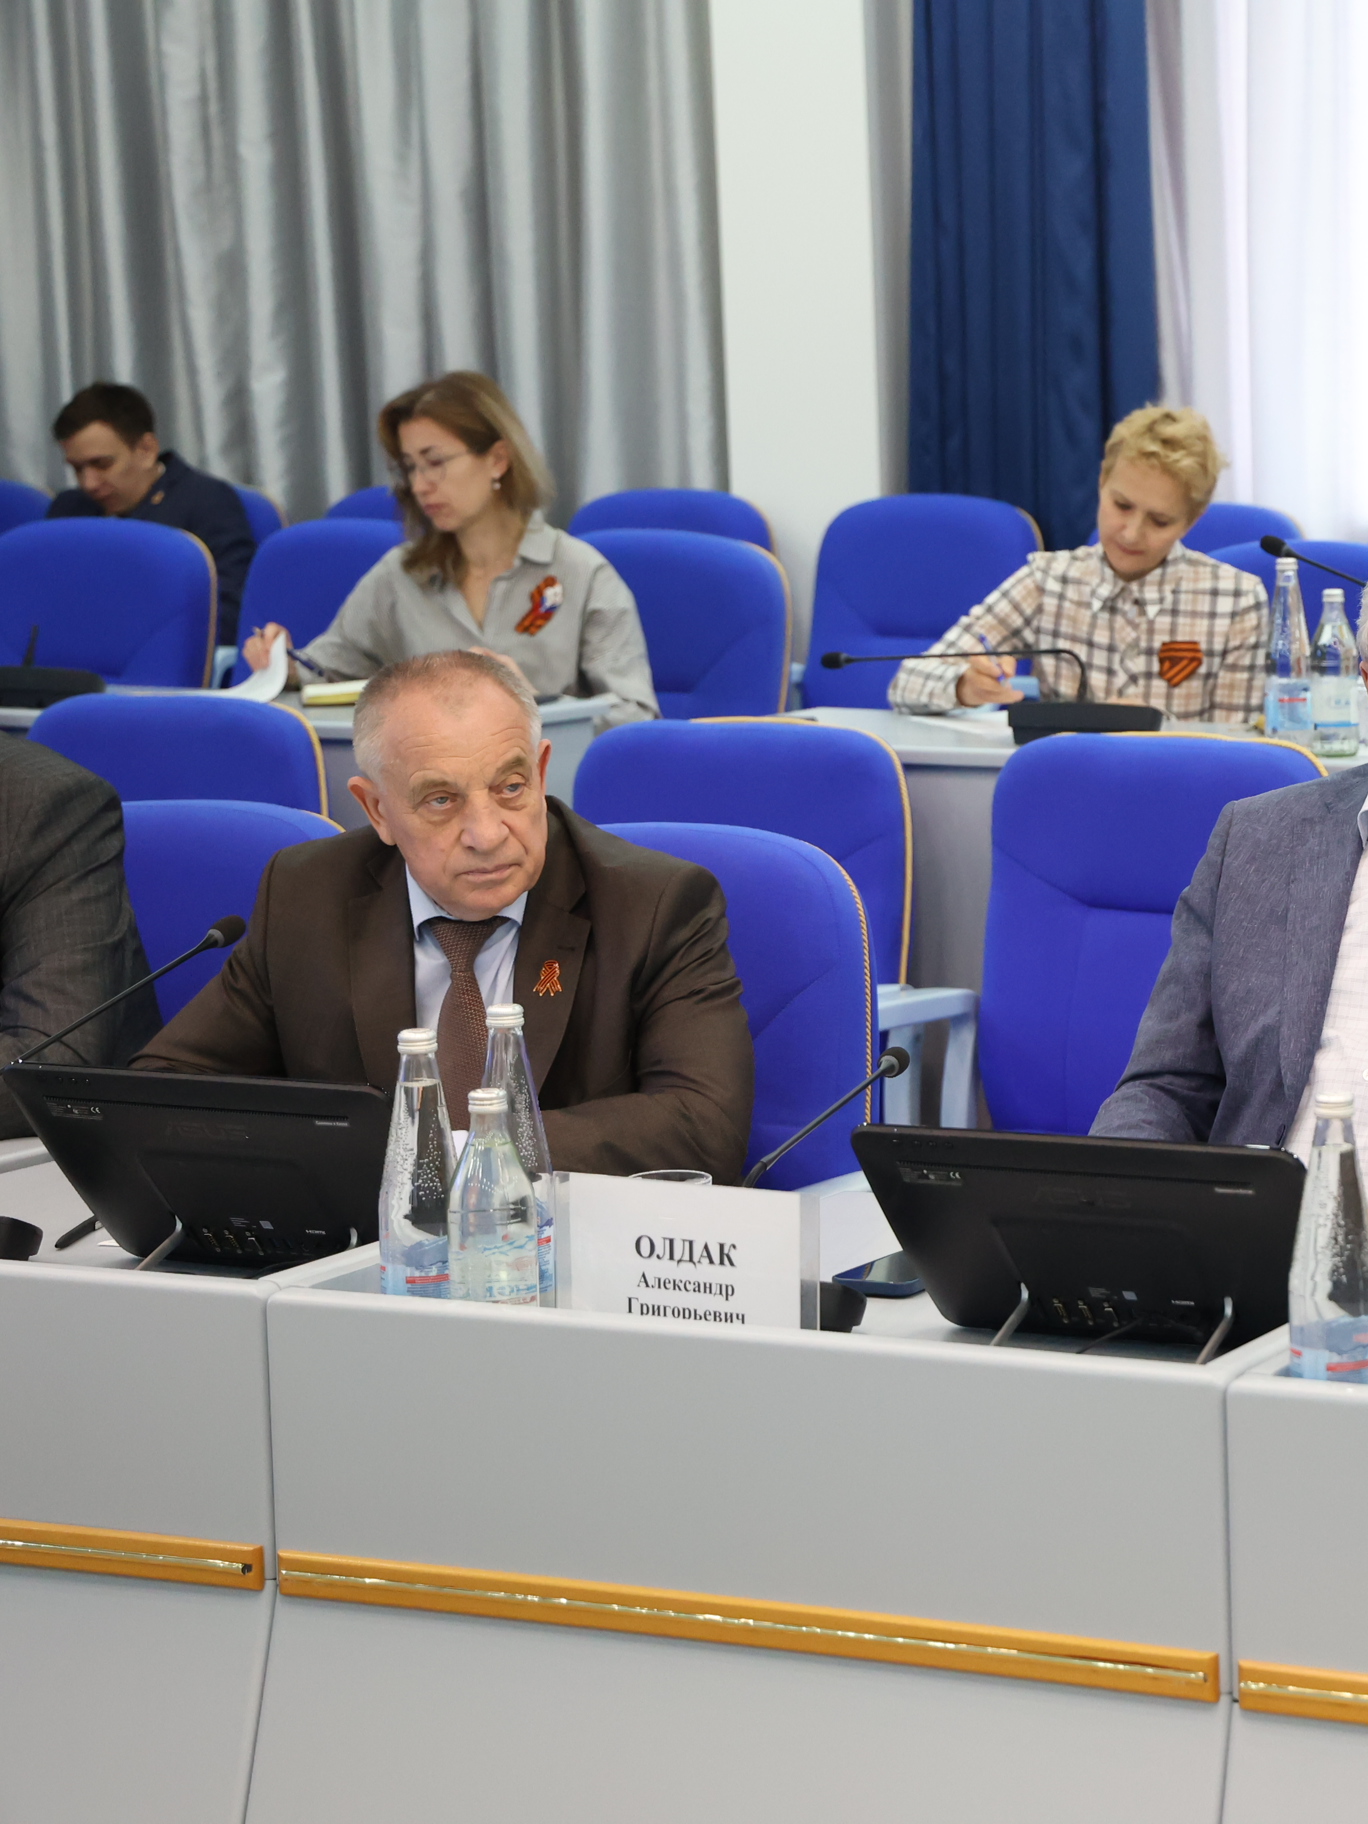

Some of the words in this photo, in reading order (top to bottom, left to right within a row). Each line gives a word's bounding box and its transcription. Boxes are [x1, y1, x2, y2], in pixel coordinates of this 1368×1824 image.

[634, 1234, 737, 1269] ОЛДАК
[636, 1271, 736, 1301] Александр
[626, 1296, 747, 1325] Григорьевич
